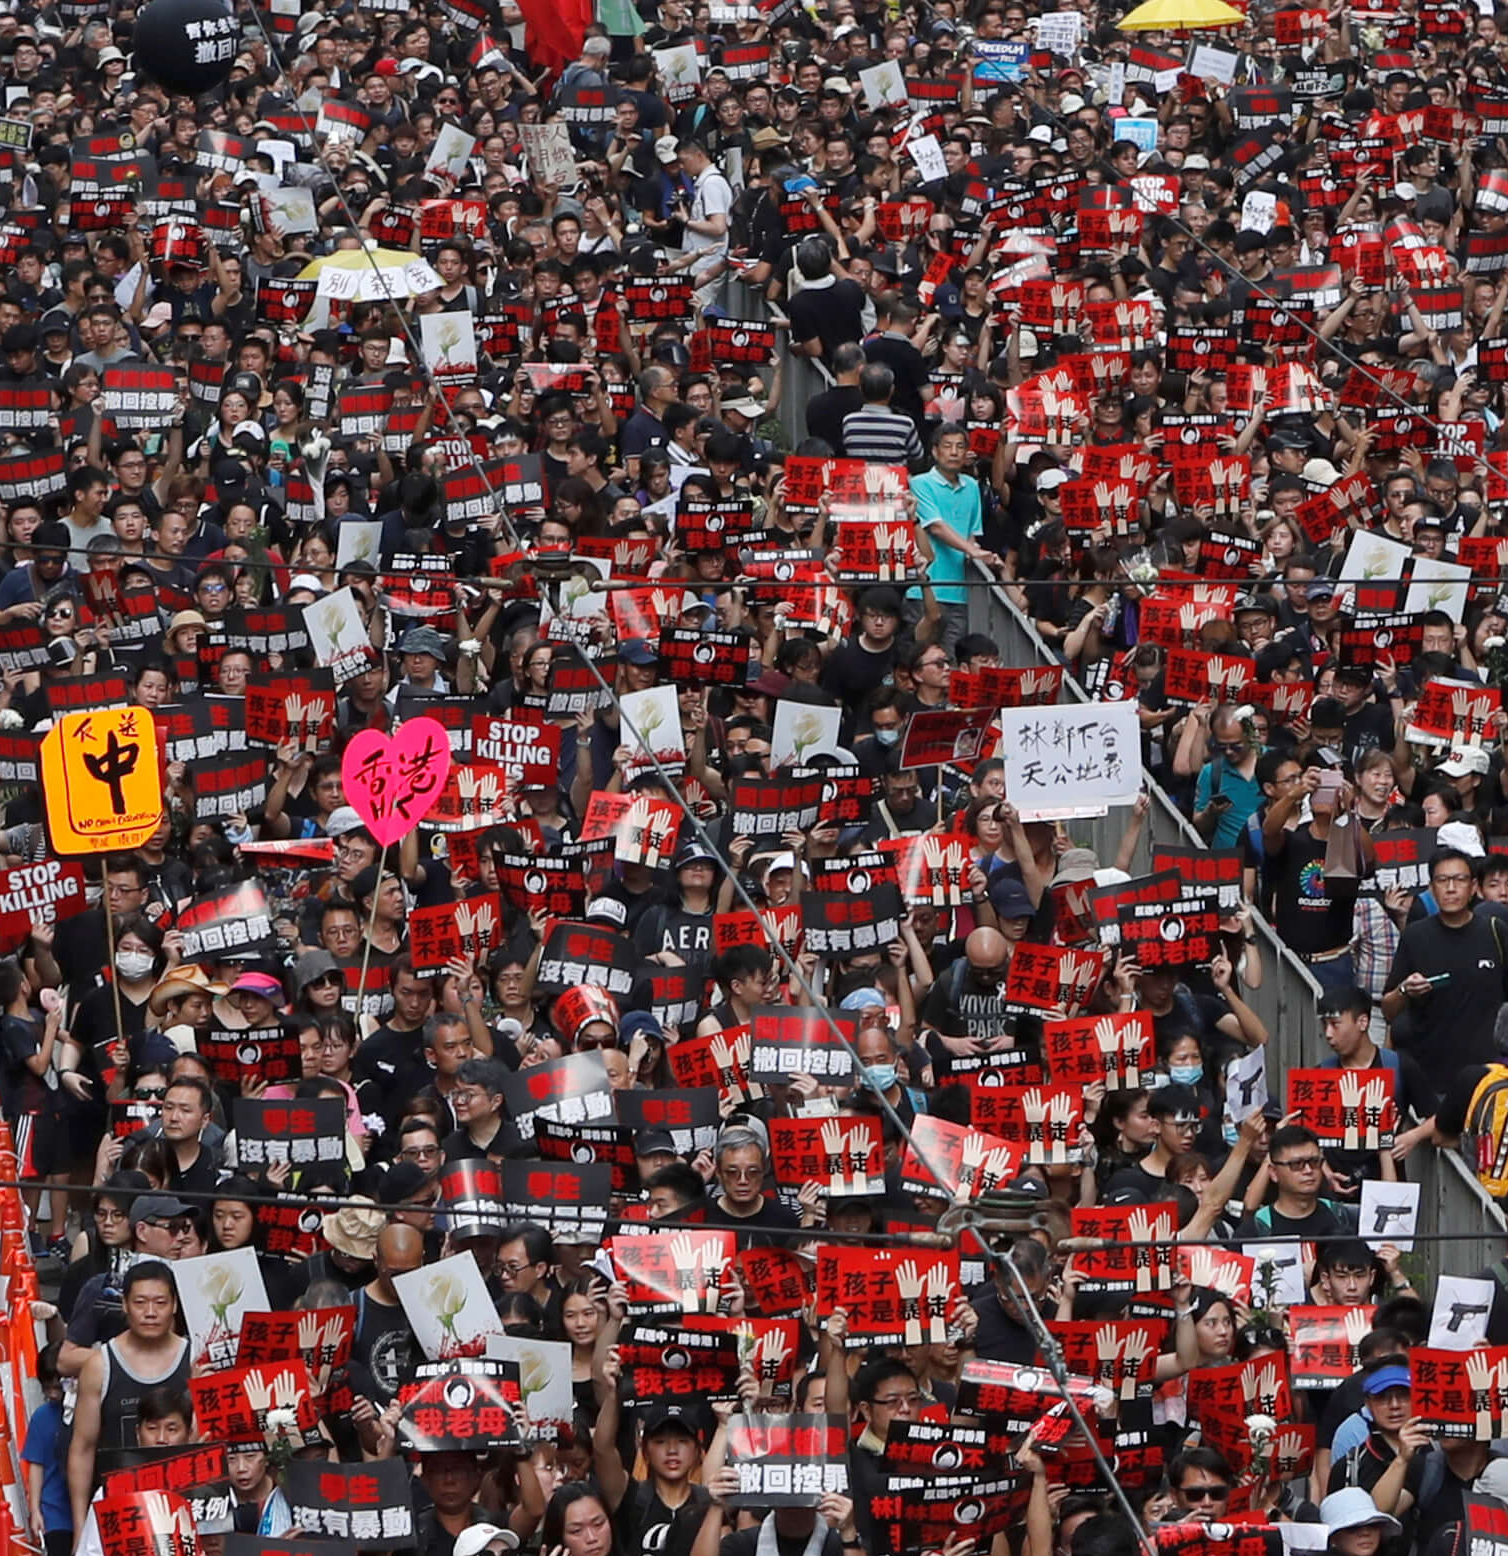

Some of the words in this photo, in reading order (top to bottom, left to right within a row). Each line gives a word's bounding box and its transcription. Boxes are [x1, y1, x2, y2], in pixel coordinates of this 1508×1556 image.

[488, 721, 541, 745] STOP
[476, 738, 552, 765] KILLING
[8, 860, 61, 891] STOP
[753, 1047, 853, 1076] 撤回控罪
